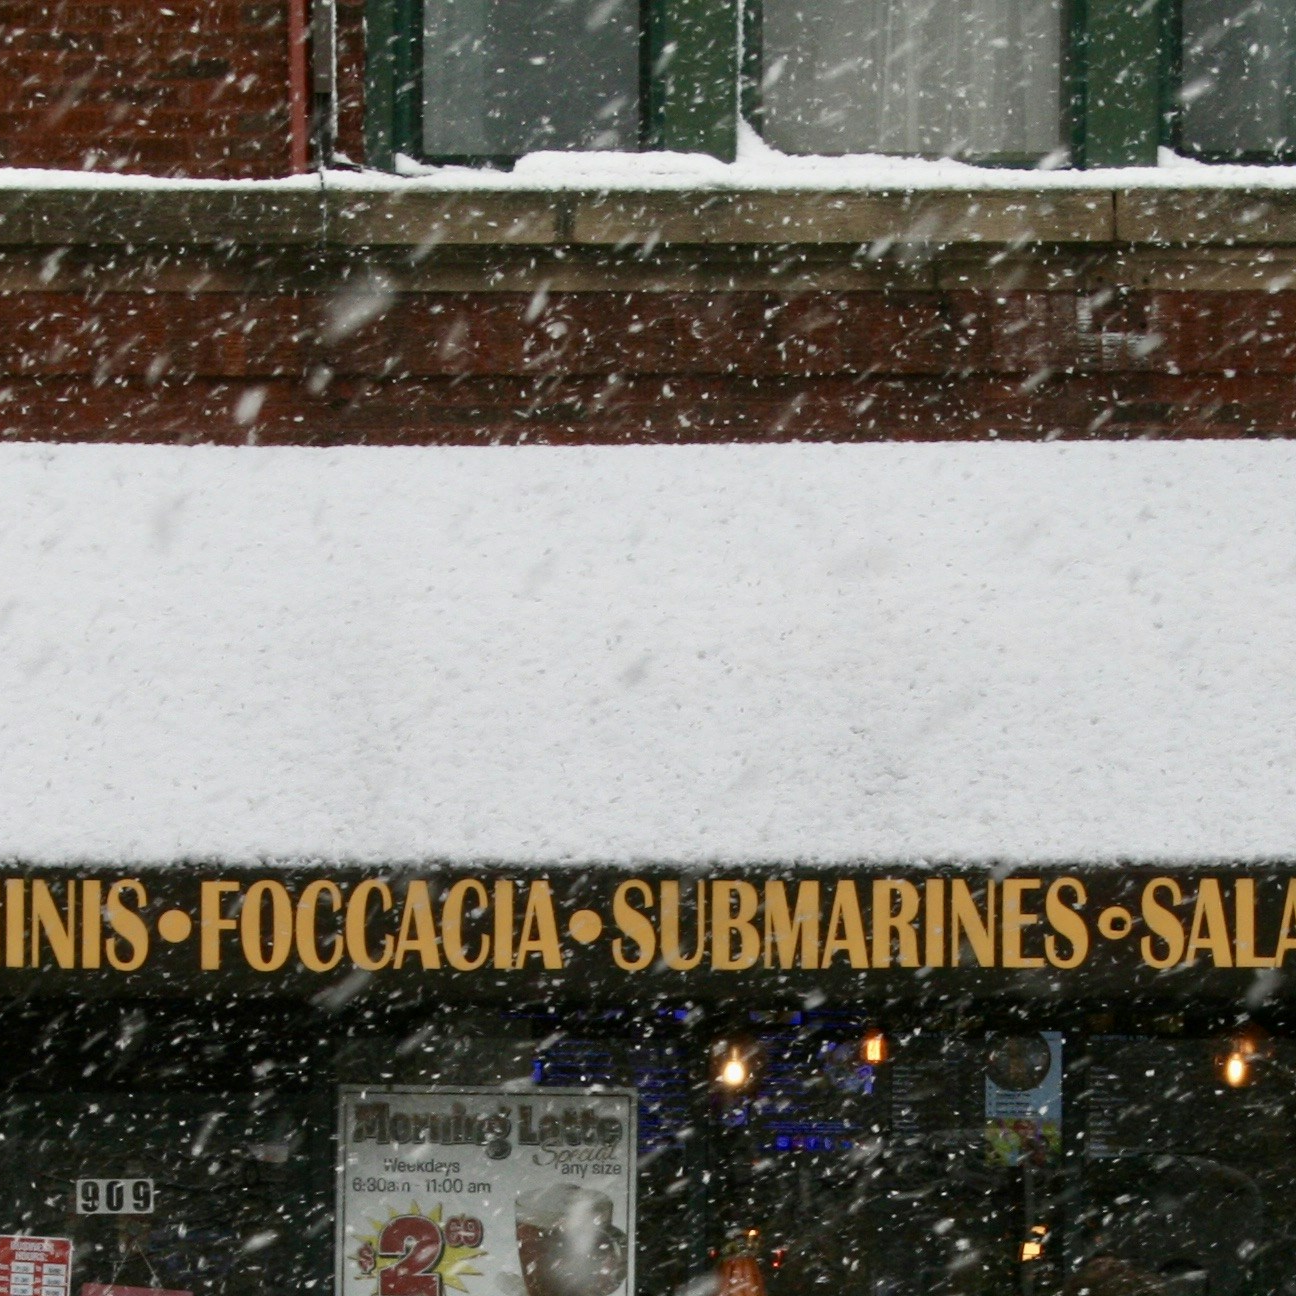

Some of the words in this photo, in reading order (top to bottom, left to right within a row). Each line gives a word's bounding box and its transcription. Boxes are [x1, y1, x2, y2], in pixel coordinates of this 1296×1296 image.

[200, 877, 564, 973] FOCCACIA
[610, 875, 1090, 972] SUBMARINES
[355, 1102, 512, 1160] Morning
[518, 1104, 624, 1146] Latte
[384, 1158, 461, 1176] Weekdays
[561, 1163, 587, 1179] any
[592, 1160, 623, 1175] size
[80, 1180, 153, 1213] 909
[425, 1178, 463, 1193] 11:00
[467, 1182, 492, 1193] am
